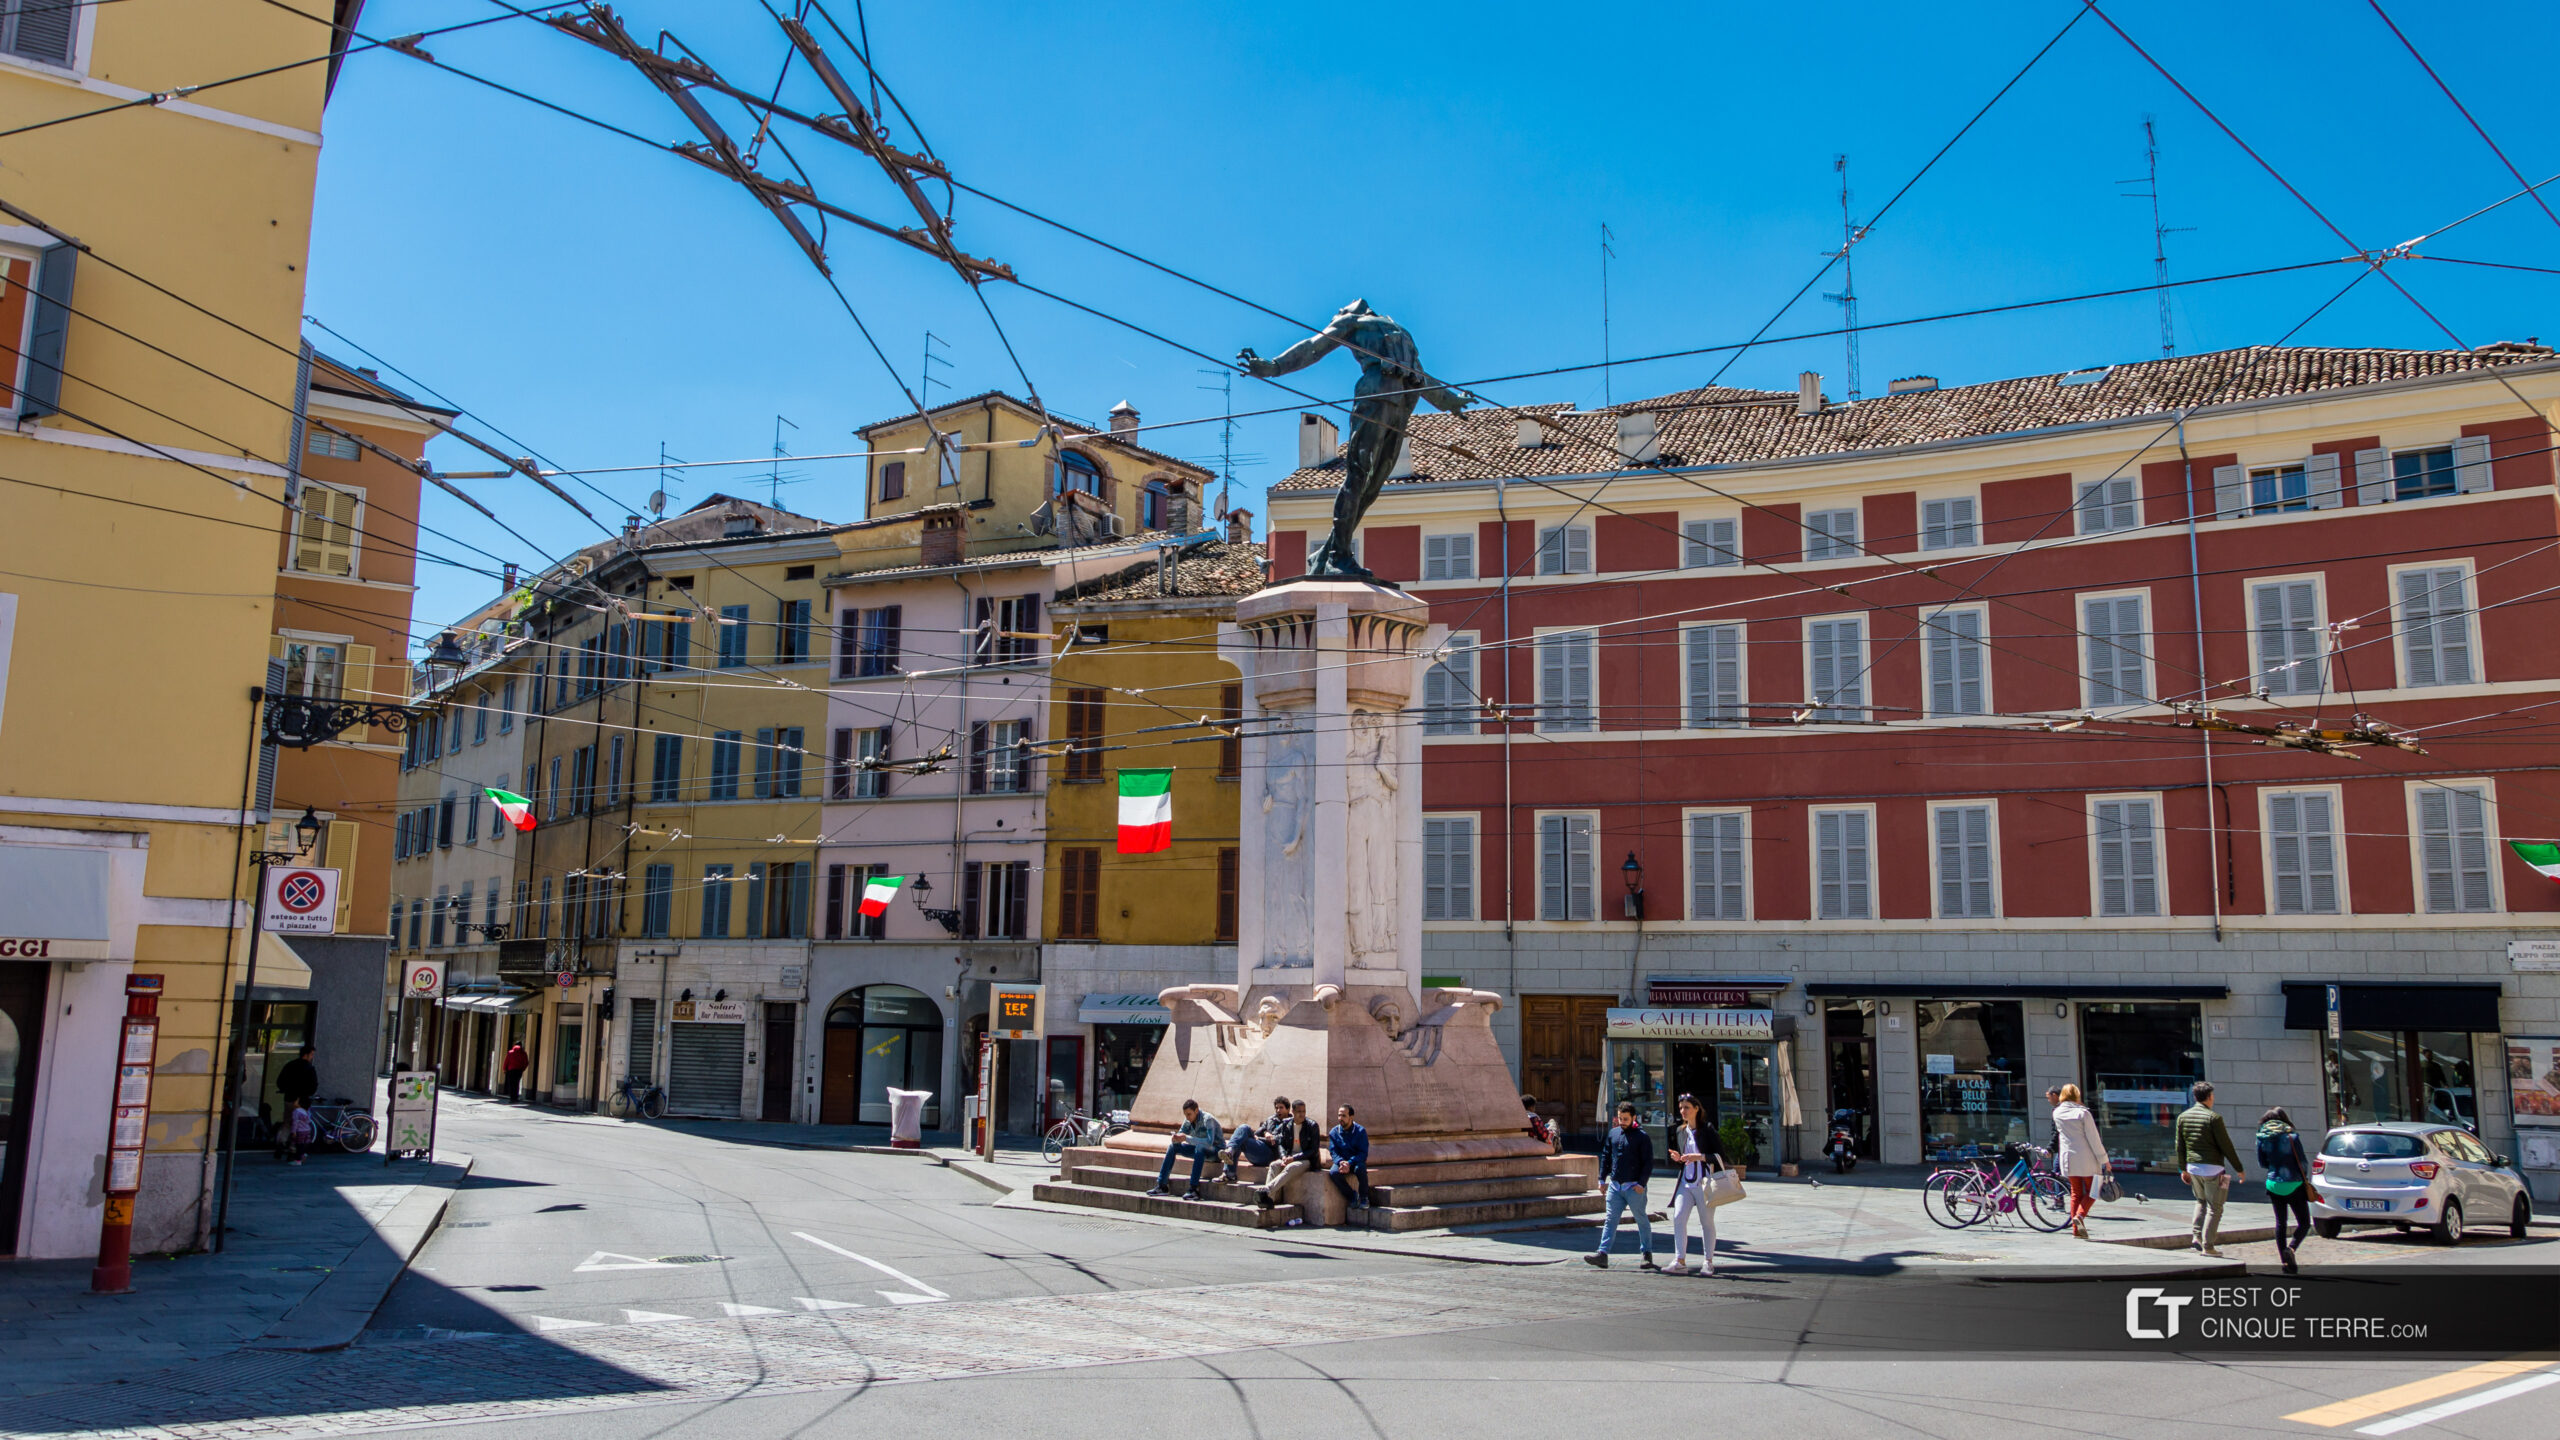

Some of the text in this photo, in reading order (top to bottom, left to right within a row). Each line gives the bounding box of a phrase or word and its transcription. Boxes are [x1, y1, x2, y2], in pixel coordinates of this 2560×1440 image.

[307, 914, 328, 922] tutto
[286, 922, 317, 930] piazzale
[1668, 991, 1701, 1001] LATTERIA
[1703, 991, 1745, 1001] CORRIDONI
[708, 1003, 737, 1011] Solari
[1004, 1002, 1028, 1012] TEP
[701, 1011, 711, 1019] Bar
[1120, 1013, 1162, 1024] Mussi
[1640, 1012, 1769, 1027] CAFFETTERIA
[1642, 1027, 1769, 1038] LATTERIA CORRIDONI
[1957, 1079, 1991, 1089] LA CASA
[1962, 1090, 1986, 1100] DELLO
[1961, 1102, 1988, 1112] STOCK
